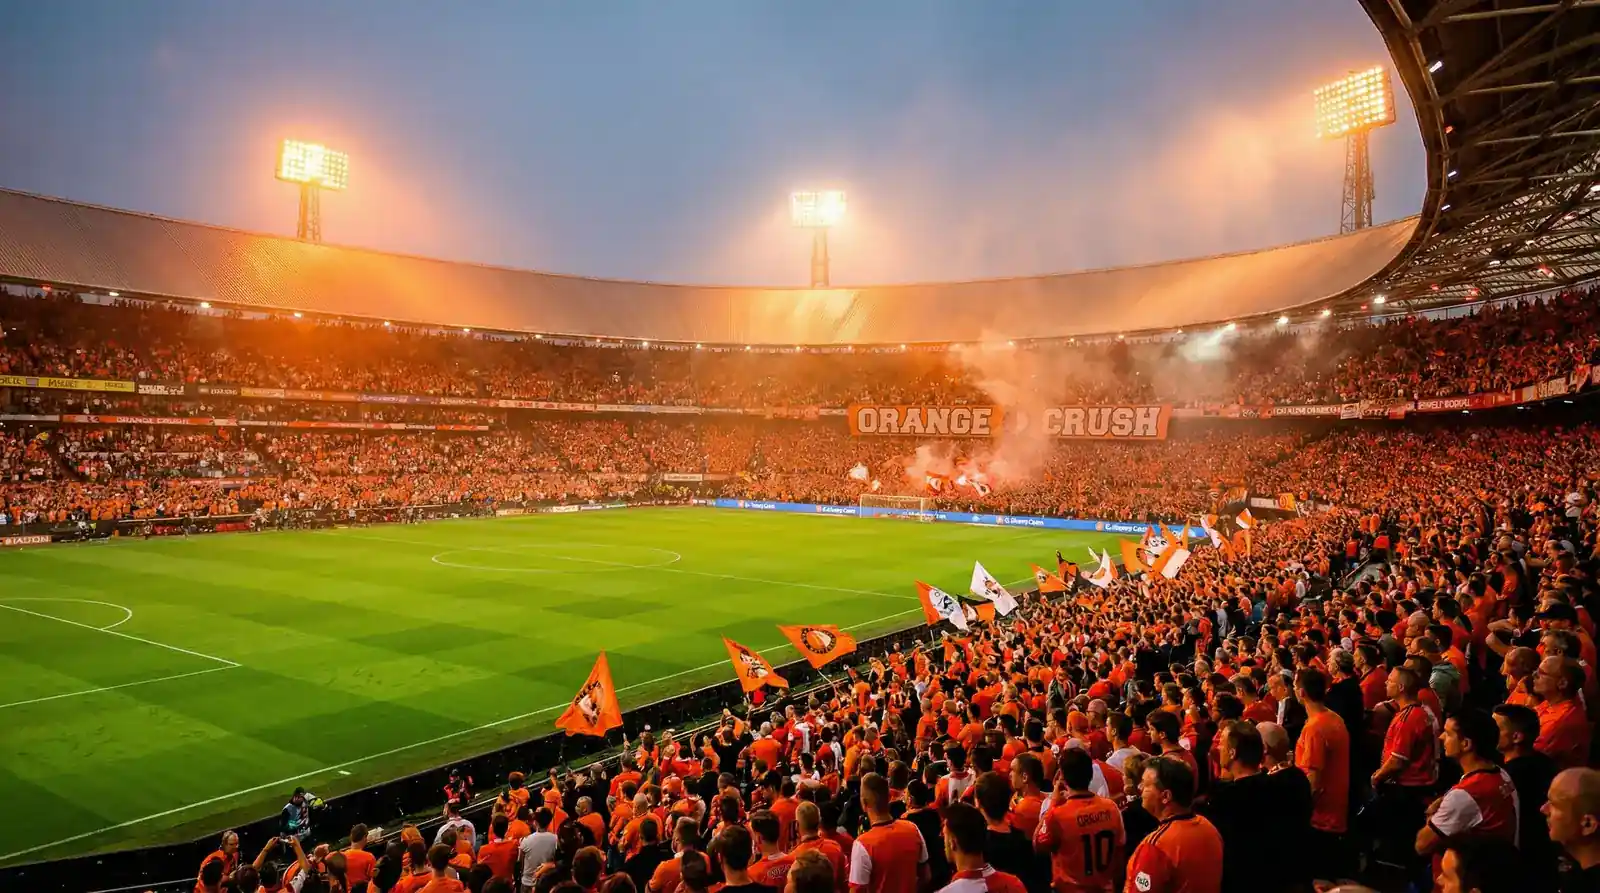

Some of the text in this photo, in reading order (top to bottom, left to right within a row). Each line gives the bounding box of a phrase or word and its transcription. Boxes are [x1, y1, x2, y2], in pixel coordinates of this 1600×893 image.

[857, 407, 1161, 437] ORANGE CRUSH
[1081, 830, 1114, 875] 10
